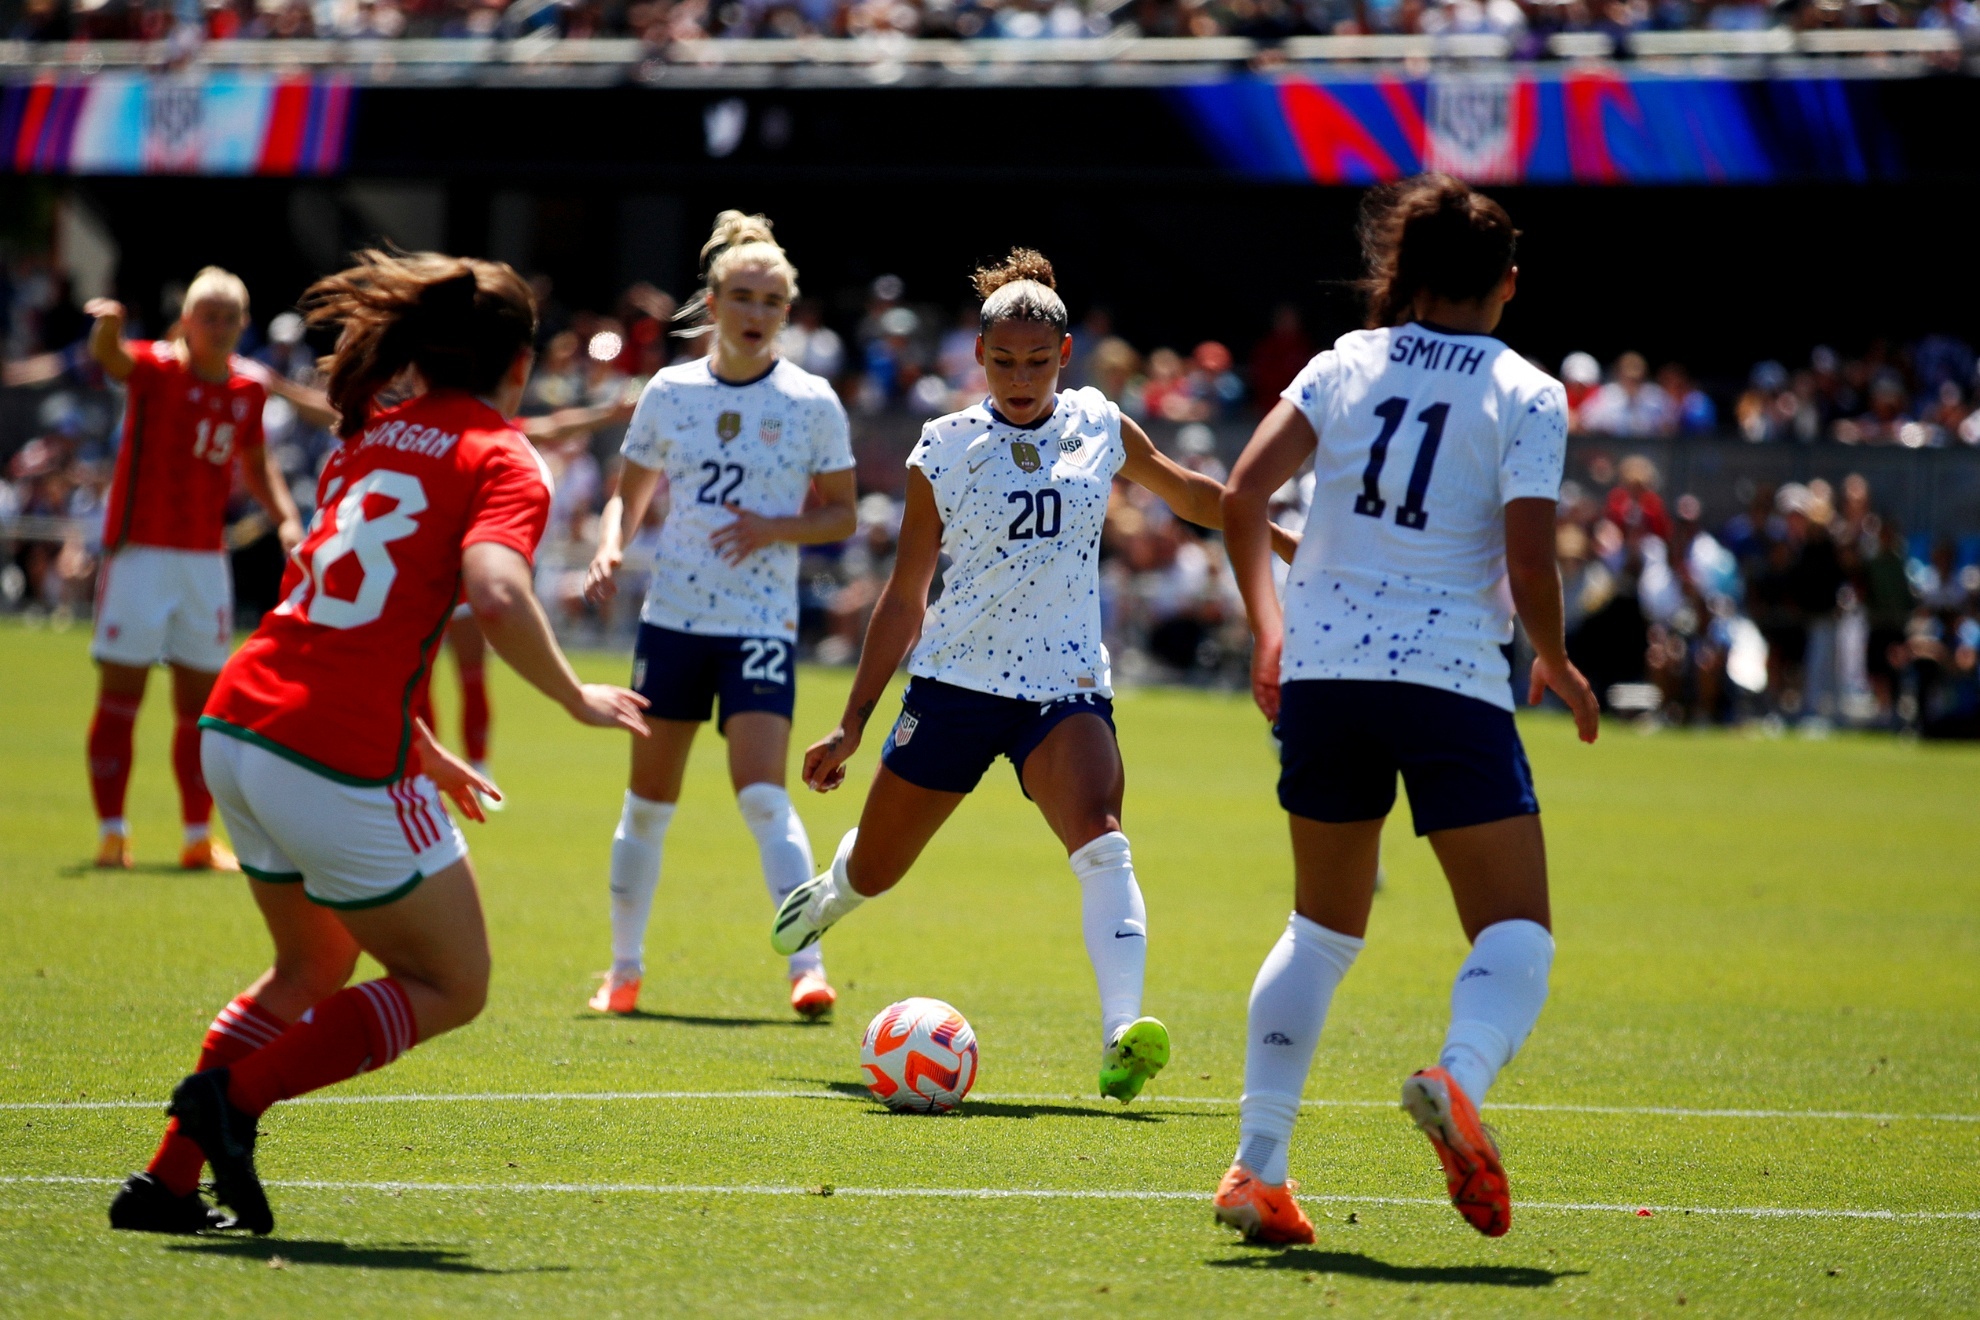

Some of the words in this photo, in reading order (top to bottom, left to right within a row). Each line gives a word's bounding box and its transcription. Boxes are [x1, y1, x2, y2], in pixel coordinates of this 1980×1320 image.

[1390, 336, 1485, 375] SMITH
[356, 420, 459, 459] ORGAN
[1060, 439, 1082, 452] USA
[697, 460, 744, 505] 22
[1353, 396, 1451, 531] 11
[1008, 488, 1061, 540] 20
[741, 639, 787, 685] 22
